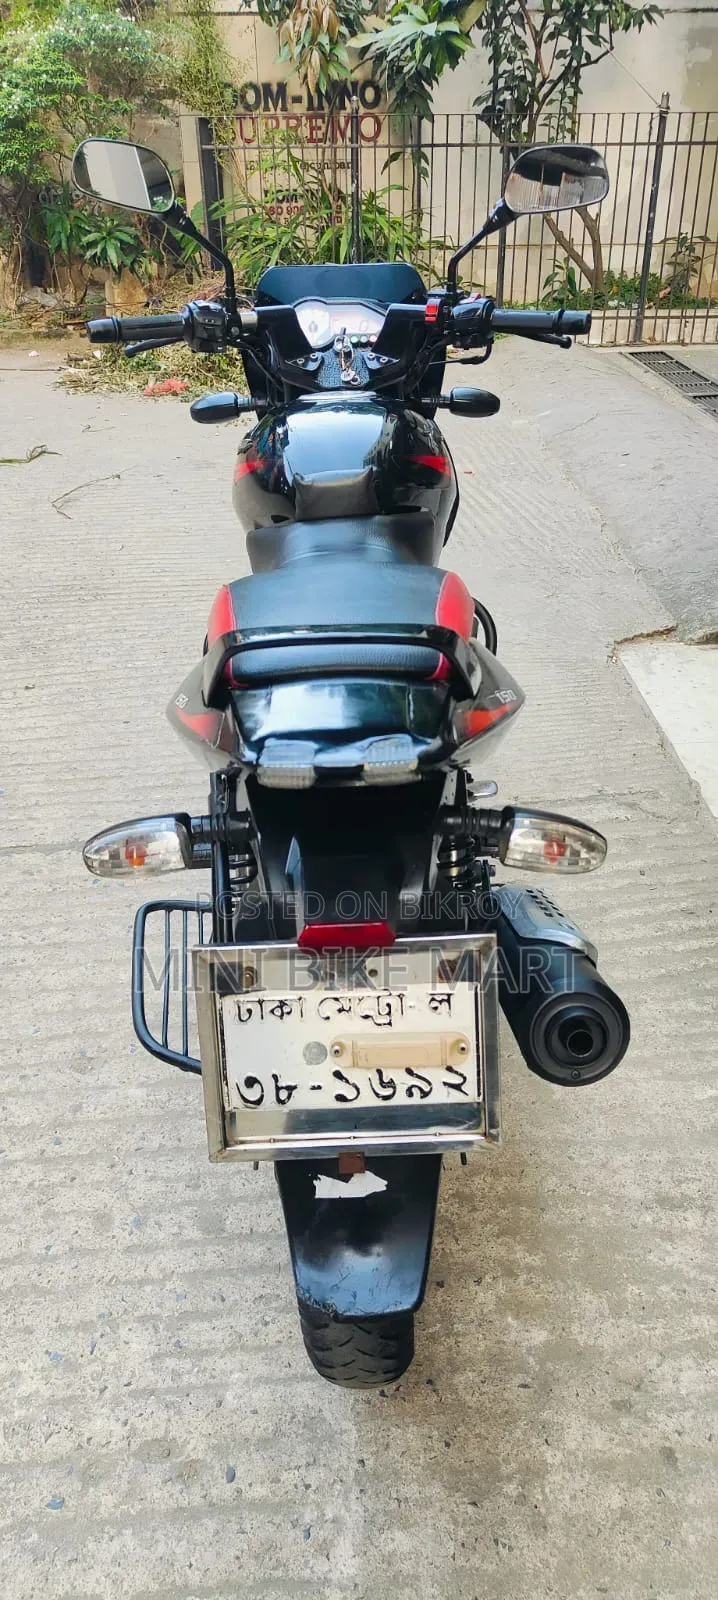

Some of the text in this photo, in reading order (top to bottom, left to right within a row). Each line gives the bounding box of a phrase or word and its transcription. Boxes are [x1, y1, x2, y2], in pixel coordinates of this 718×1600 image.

[224, 80, 381, 112] OM-INNO
[236, 112, 382, 143] UPREMO
[234, 995, 305, 1023] ঢাকা
